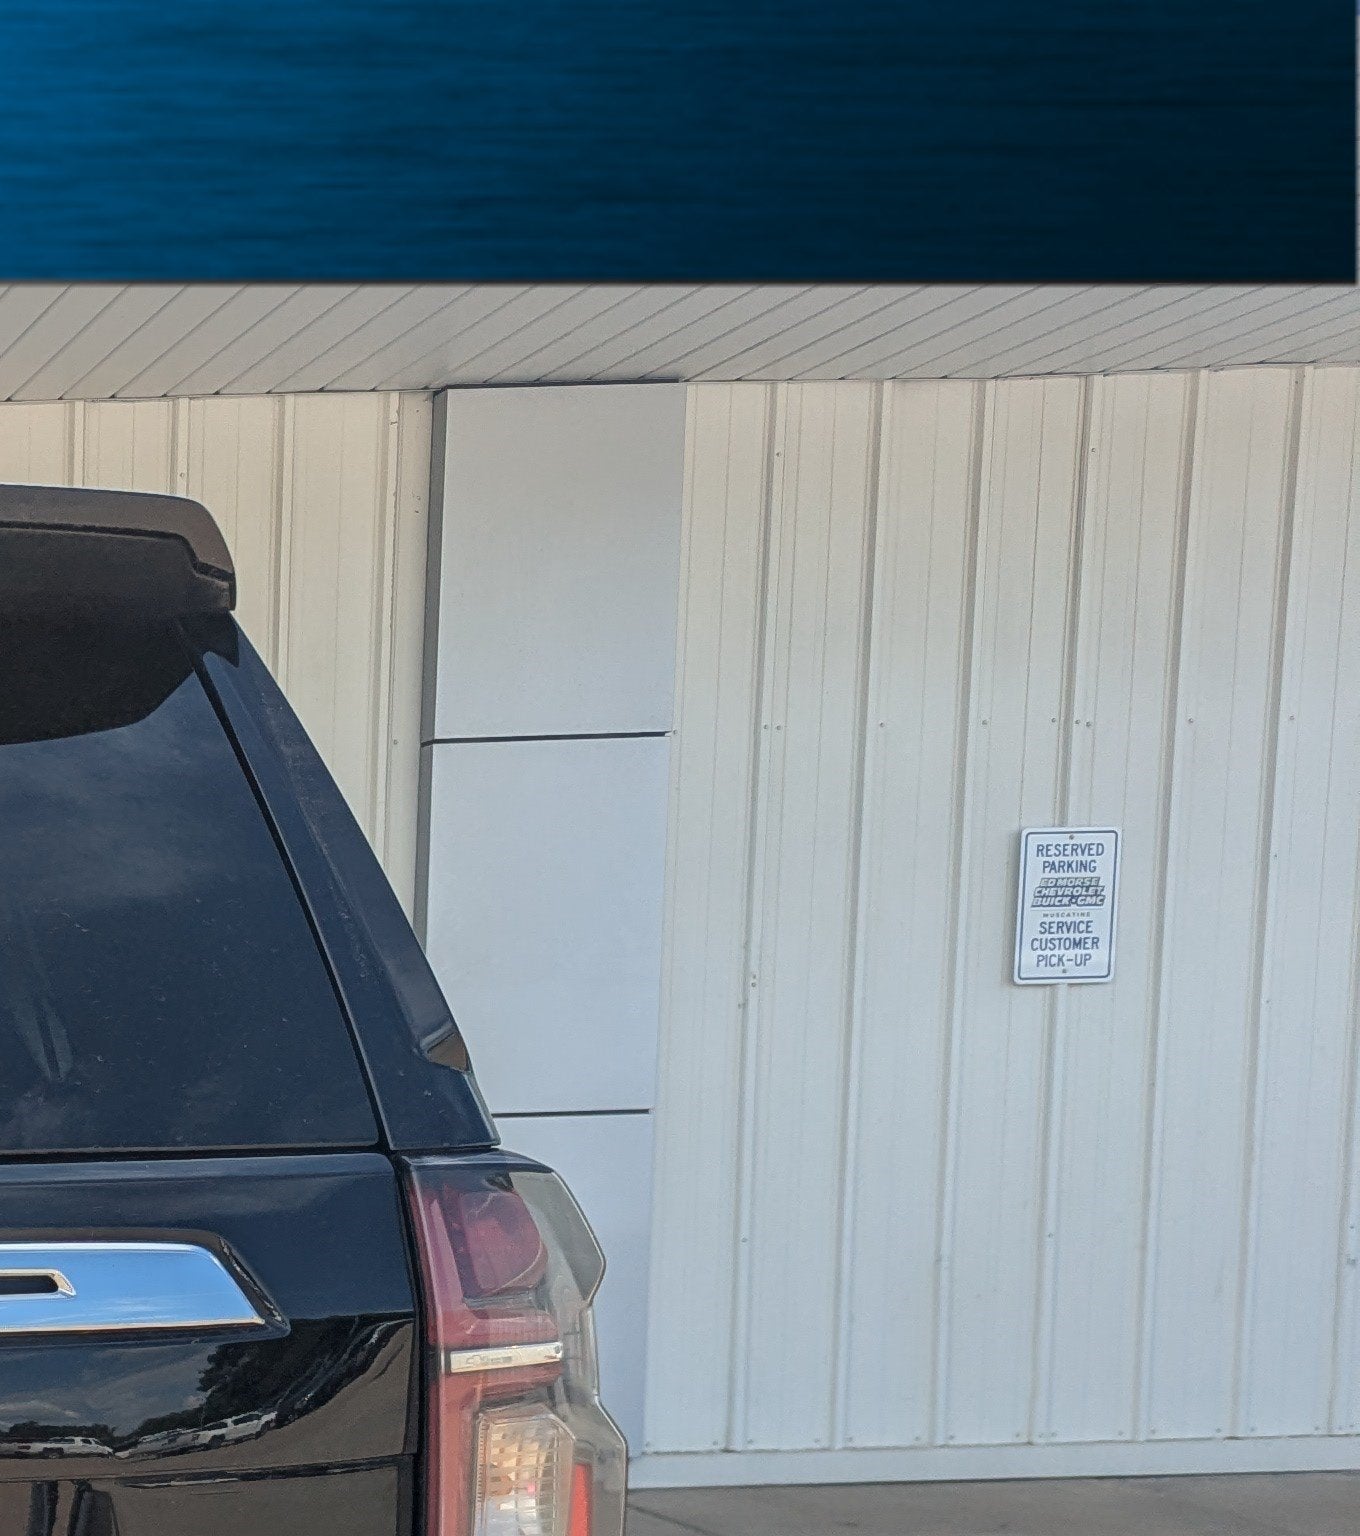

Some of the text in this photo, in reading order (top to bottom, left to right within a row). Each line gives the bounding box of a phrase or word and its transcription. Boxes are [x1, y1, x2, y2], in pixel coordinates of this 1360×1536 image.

[1036, 843, 1105, 857] RESERVED
[1042, 859, 1097, 874] PARKING
[1040, 876, 1100, 887] ED MORSE
[1034, 886, 1105, 896] CHEVROLET
[1039, 920, 1094, 935] SERVICE
[1030, 937, 1100, 952] CUSTOMER
[1036, 953, 1092, 968] PICK-UP
